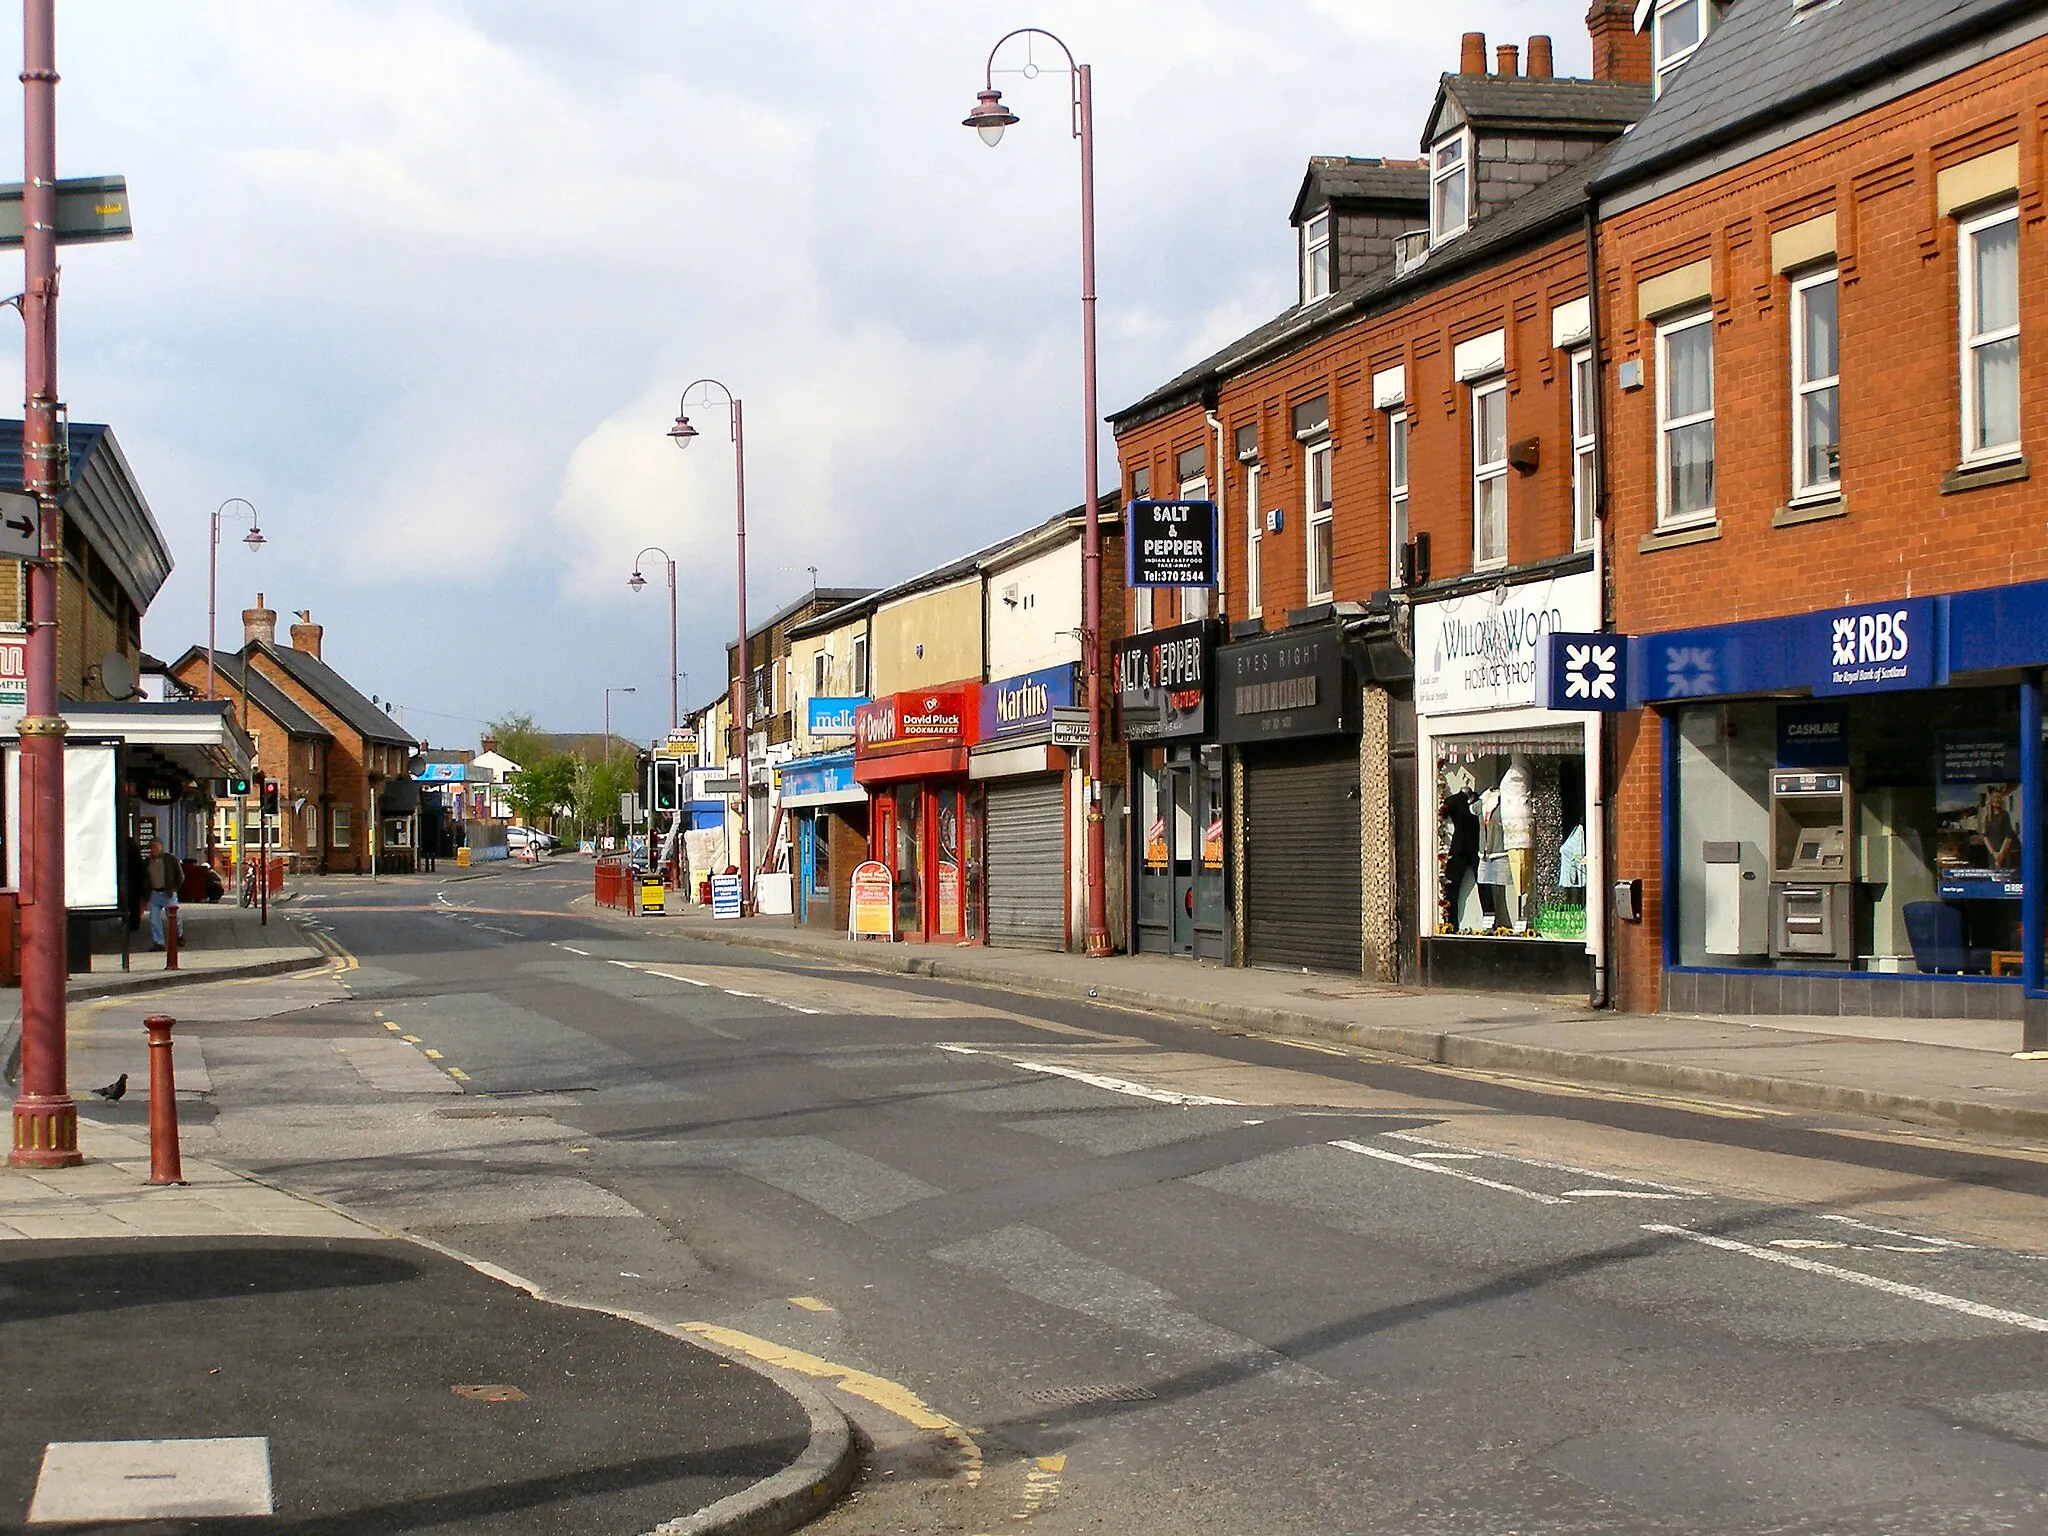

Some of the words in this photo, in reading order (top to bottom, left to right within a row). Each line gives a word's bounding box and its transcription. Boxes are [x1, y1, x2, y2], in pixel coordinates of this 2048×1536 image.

[1153, 505, 1190, 522] SALT
[1168, 523, 1177, 538] &
[1144, 539, 1203, 556] PEPPER
[1180, 570, 1204, 581] 2544
[1858, 610, 1909, 664] RBS
[1113, 649, 1141, 694] SALT
[1142, 653, 1150, 690] &
[1152, 637, 1200, 688] PEPPER
[1237, 653, 1268, 674] EYES
[1279, 644, 1319, 668] RIGHT
[1506, 660, 1536, 686] SHOP
[1833, 671, 1843, 683] The
[1843, 669, 1859, 685] Royal
[1859, 667, 1874, 681] Bank
[1874, 666, 1881, 683] of
[1881, 664, 1907, 679] Scotland
[996, 677, 1048, 723] Martins
[867, 708, 887, 742] David
[903, 714, 932, 724] David
[932, 714, 960, 724] Pluck
[905, 726, 958, 734] BOOKMAKERS
[1788, 722, 1840, 736] CASHLINE
